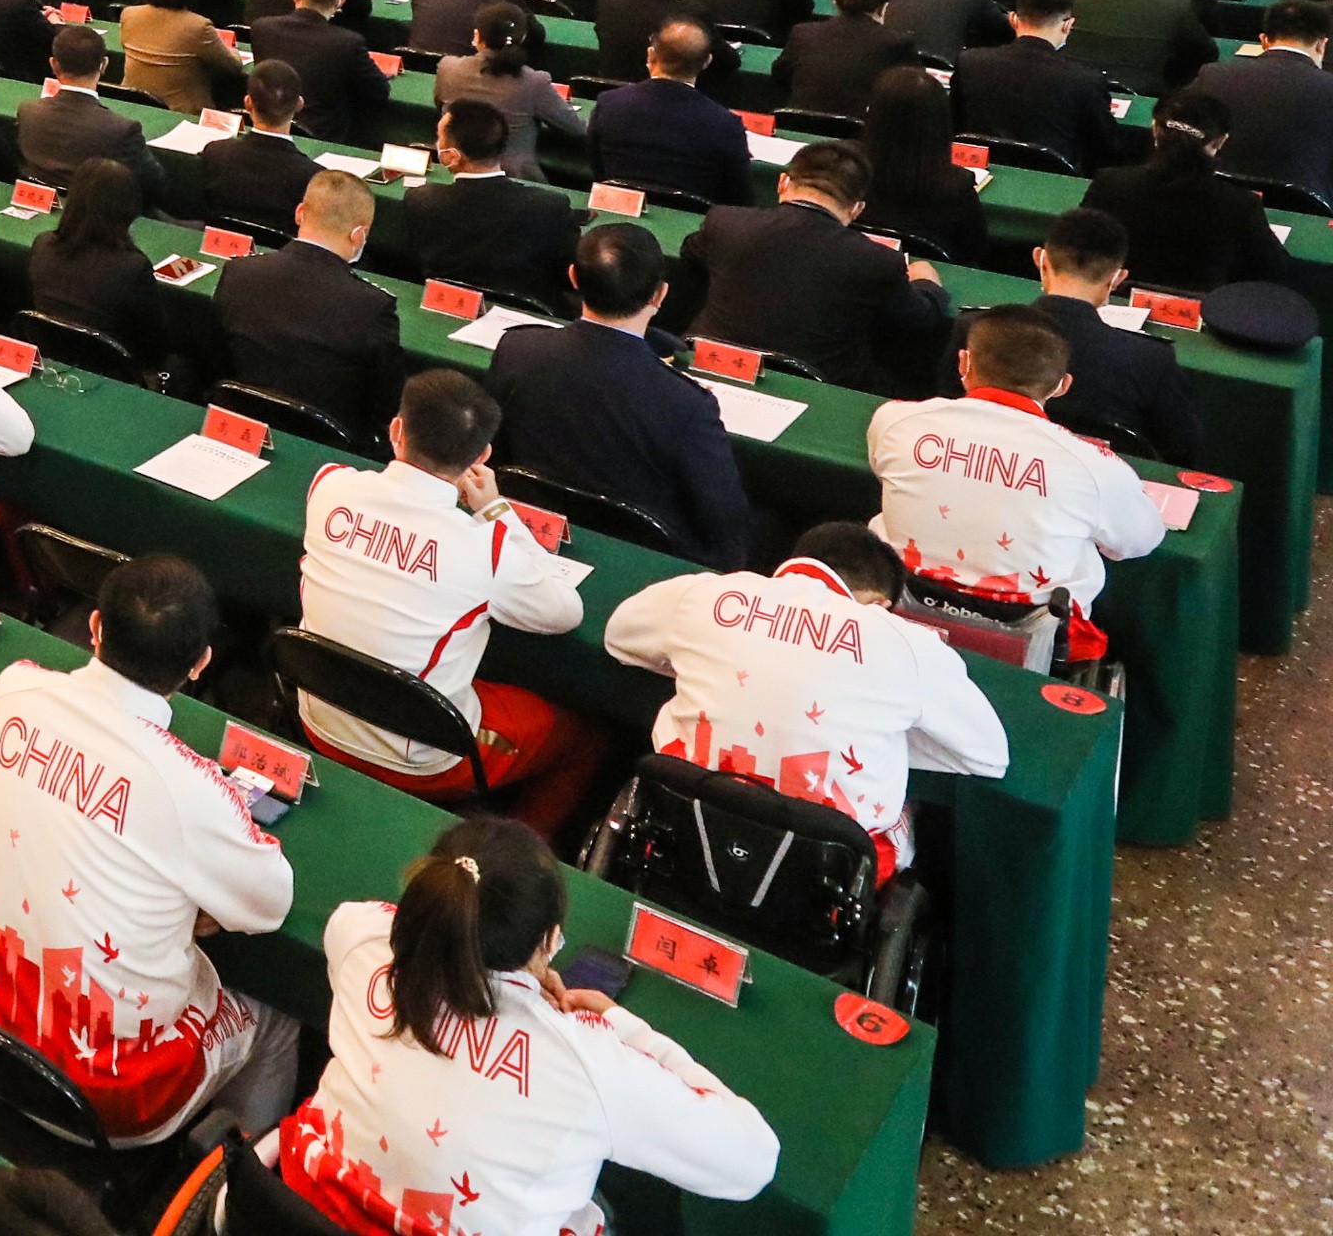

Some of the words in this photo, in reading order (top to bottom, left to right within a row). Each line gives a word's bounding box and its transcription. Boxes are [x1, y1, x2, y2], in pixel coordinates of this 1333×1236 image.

[913, 433, 1048, 498] CHINA
[323, 506, 439, 583] CHINA
[713, 590, 864, 665] CHINA
